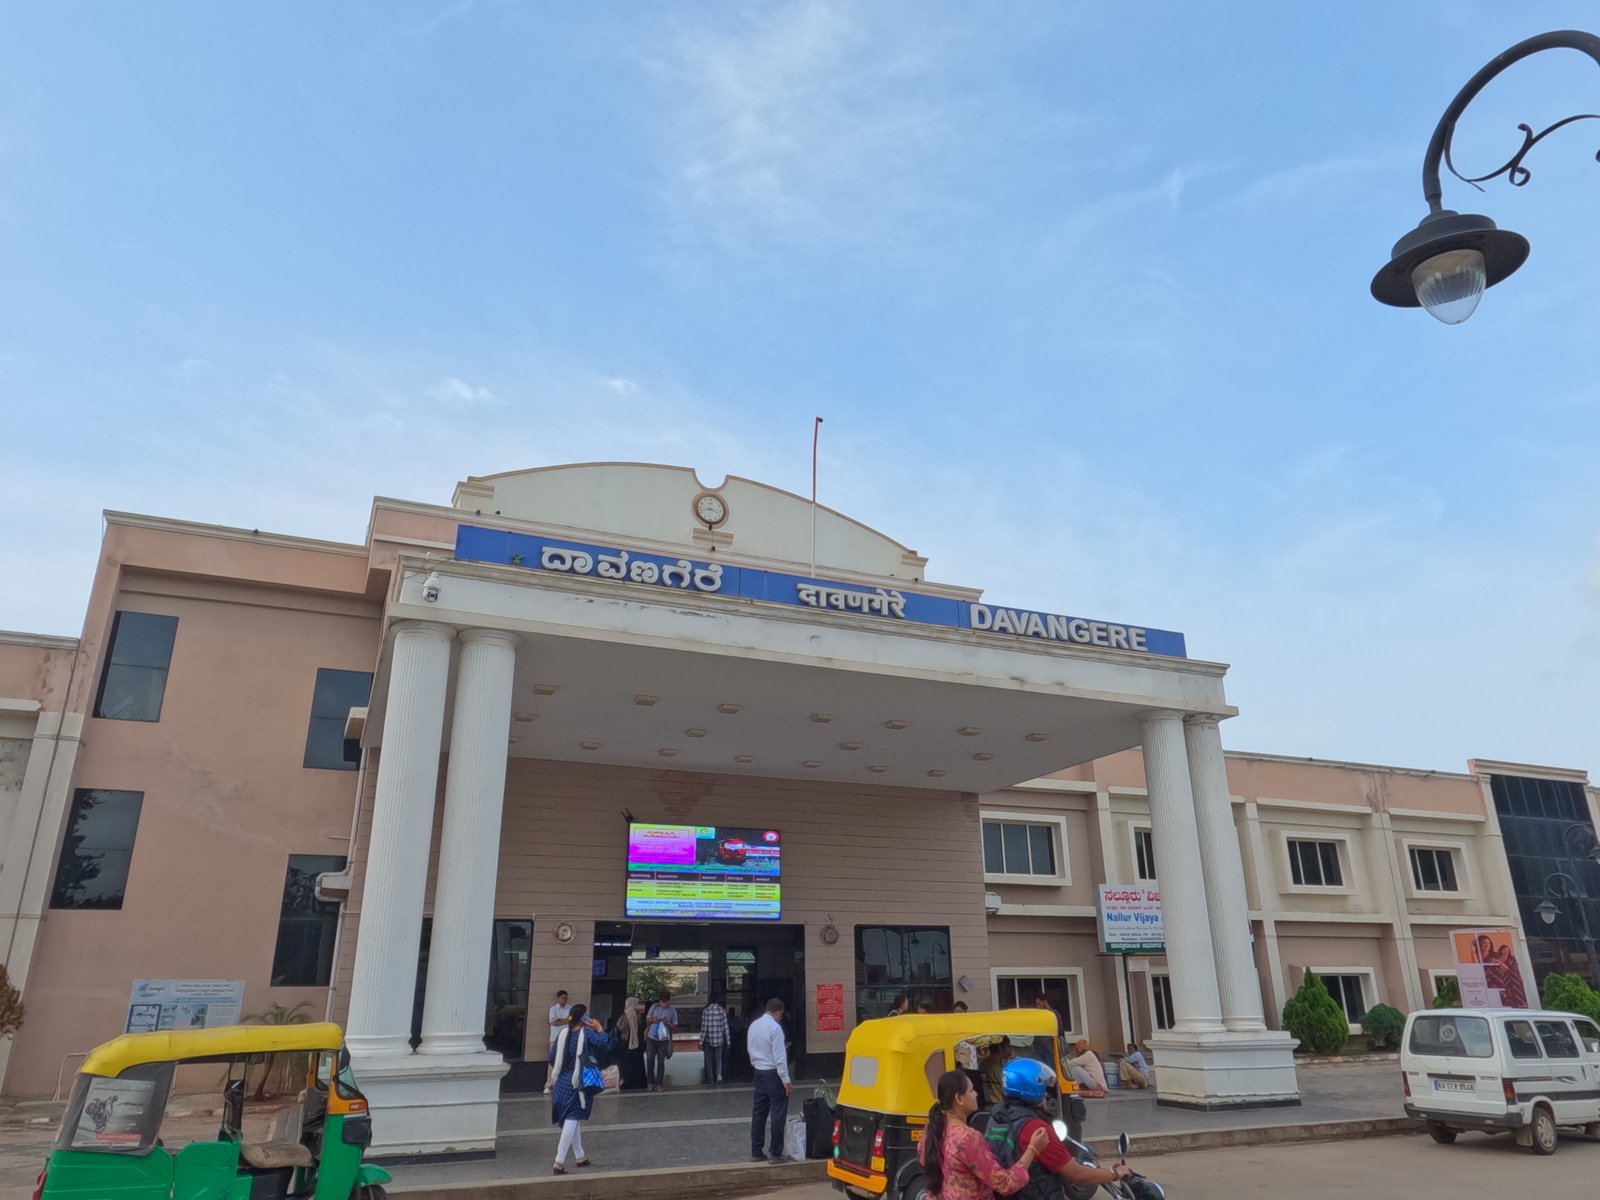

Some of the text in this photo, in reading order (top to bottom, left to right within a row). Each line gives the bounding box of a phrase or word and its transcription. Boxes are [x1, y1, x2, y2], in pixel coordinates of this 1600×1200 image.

[541, 546, 724, 592] ದಾವಣಗೆರೆ
[796, 583, 907, 618] दावणगेरे
[969, 603, 1148, 652] DAVANGERE
[1106, 912, 1159, 924] Nallur Vijaya
